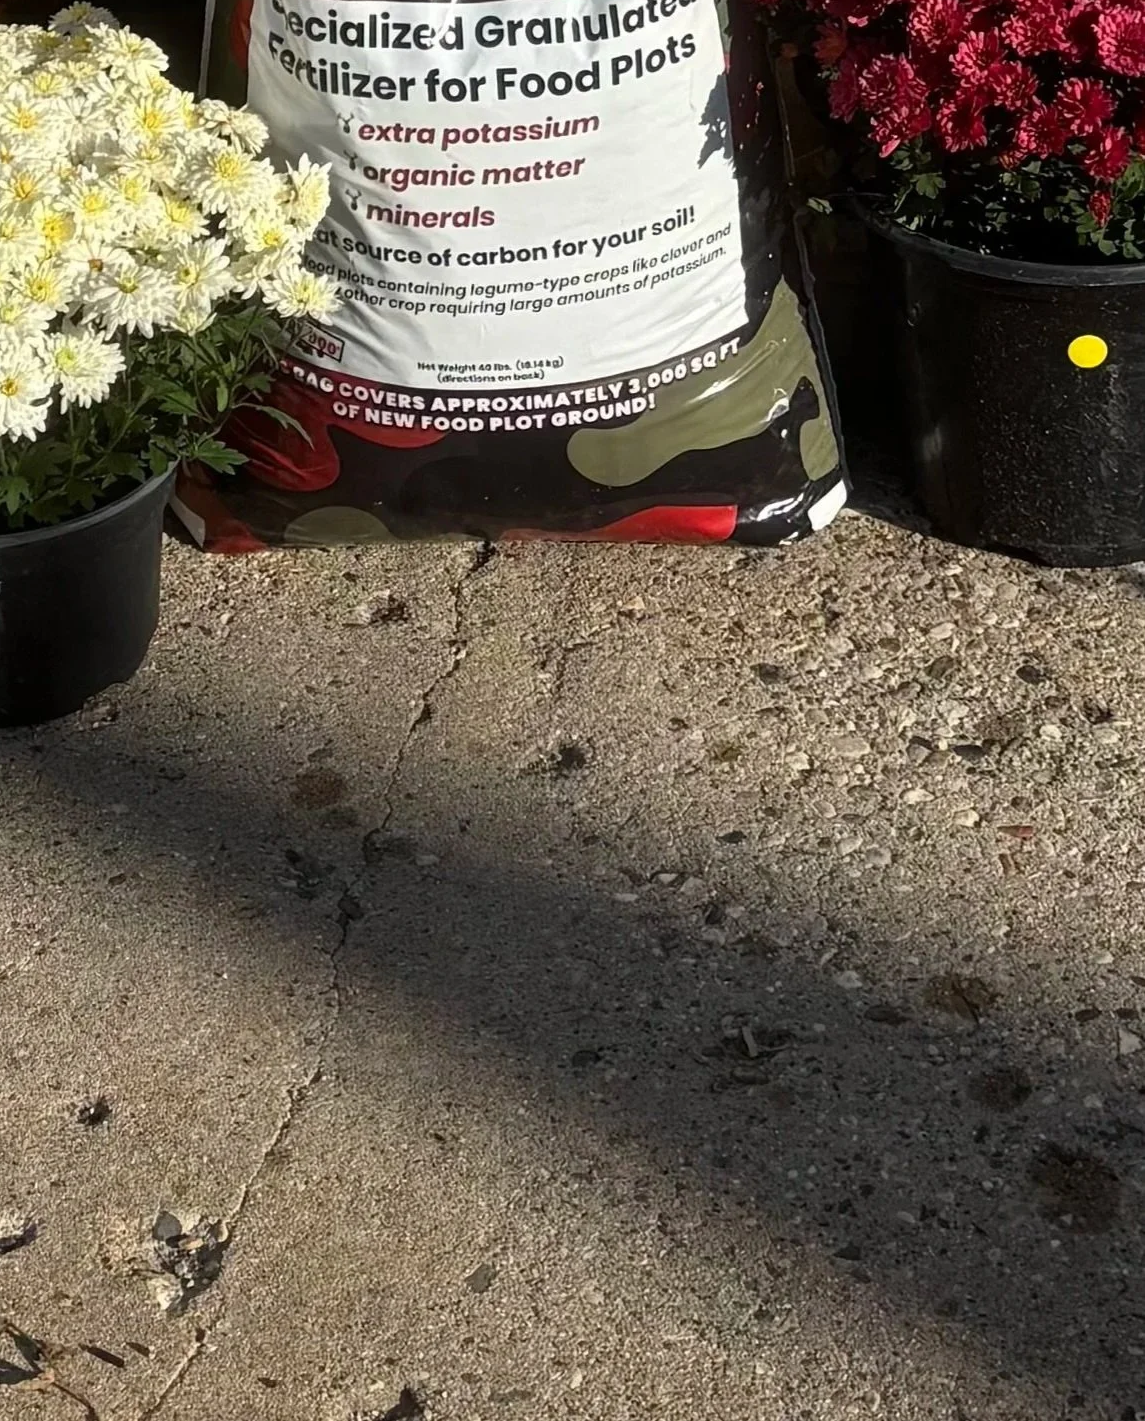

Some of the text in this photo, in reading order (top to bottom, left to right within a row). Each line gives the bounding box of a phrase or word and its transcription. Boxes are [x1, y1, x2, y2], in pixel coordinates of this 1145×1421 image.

[268, 30, 696, 102] Fertilizer for Food Plots
[358, 115, 600, 152] extra potassium
[363, 157, 586, 193] organic matter
[366, 203, 496, 229] minerals
[342, 237, 423, 264] source
[427, 248, 452, 267] of
[456, 245, 548, 267] carbon
[552, 239, 588, 258] for
[592, 225, 647, 257] your
[651, 205, 696, 236] soil!
[338, 268, 374, 287] plots
[377, 279, 467, 299] containing
[471, 274, 581, 299] legume-type
[584, 264, 629, 285] crops
[633, 256, 657, 273] like
[660, 238, 704, 265] clover
[706, 223, 731, 245] and
[344, 246, 727, 317] other crop requiring large amounts of potassium.
[339, 382, 426, 410] COVERS
[430, 381, 624, 413] APPROXIMATELY
[628, 363, 688, 394] 3,000
[690, 351, 717, 374] SQ
[719, 337, 740, 362] FT
[417, 362, 436, 371] Net
[438, 362, 476, 373] Weight
[478, 362, 492, 371] 40
[437, 373, 496, 383] (directions
[333, 393, 656, 432] OF NEW FOOD PLOT GROUND!
